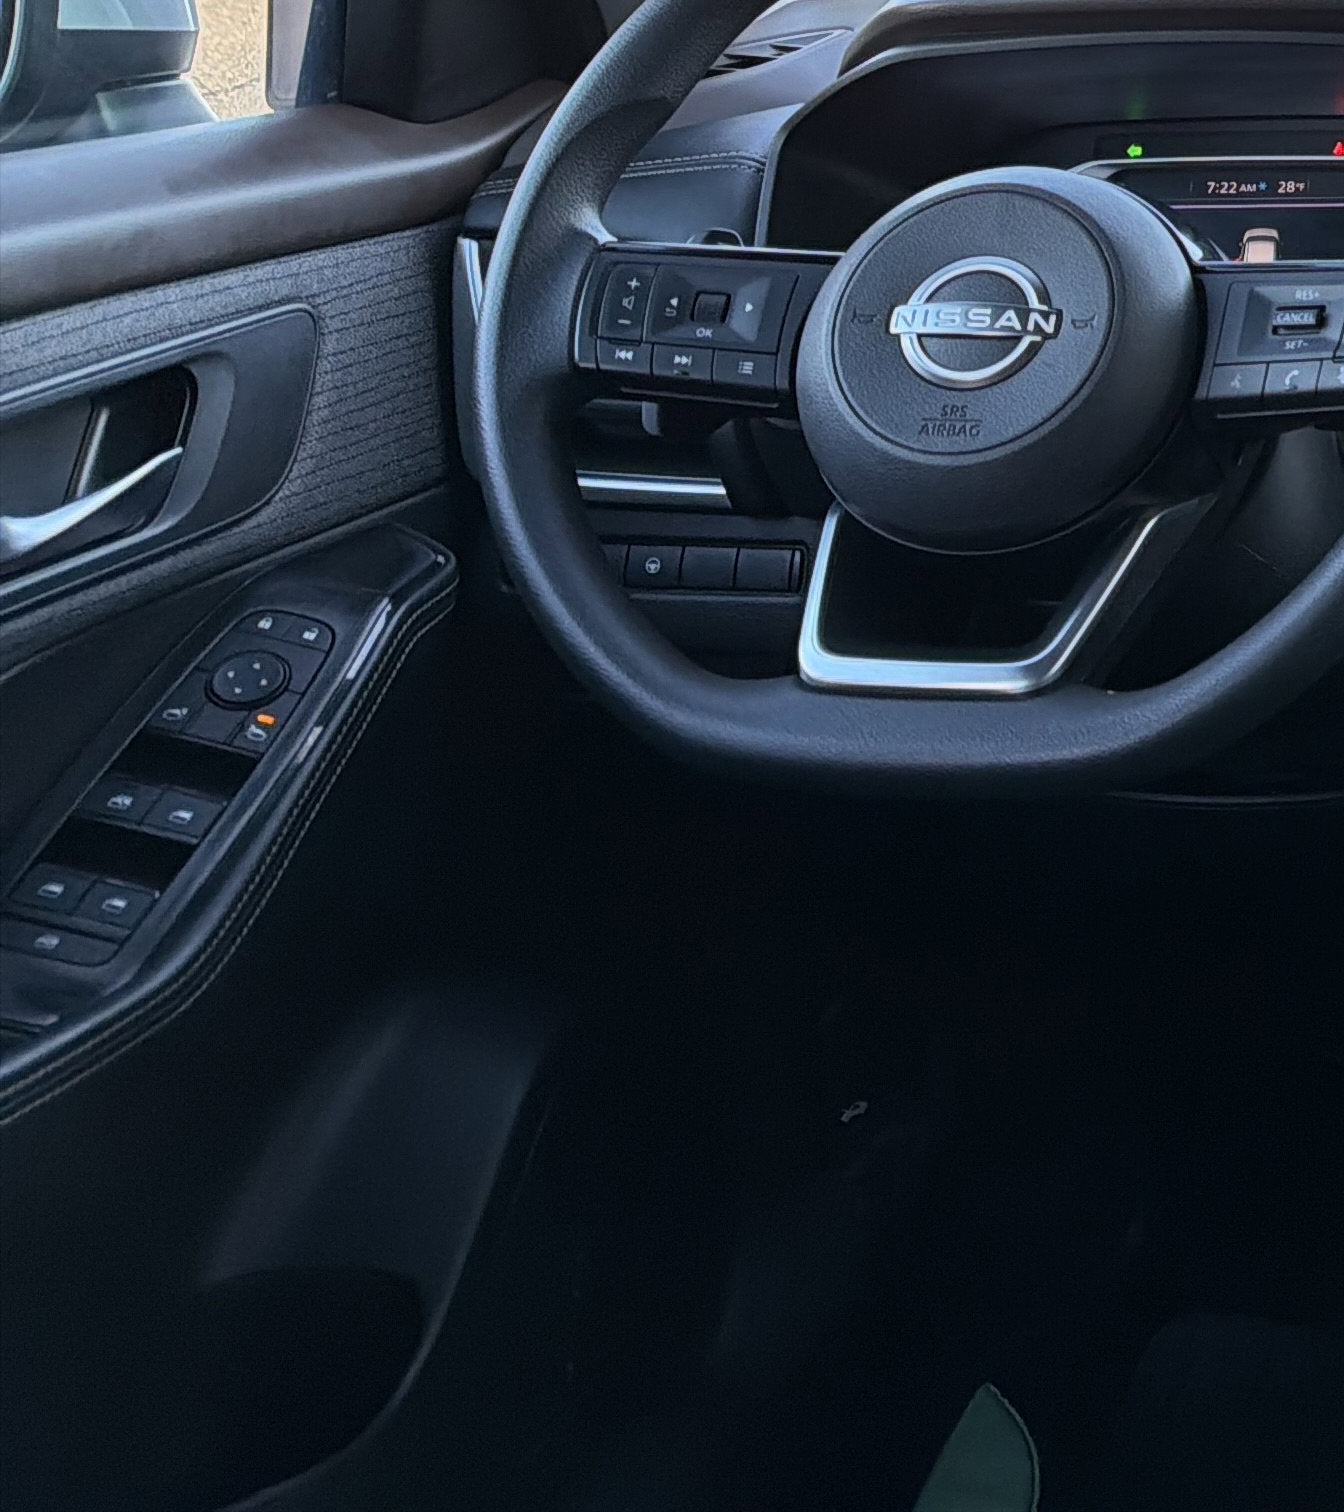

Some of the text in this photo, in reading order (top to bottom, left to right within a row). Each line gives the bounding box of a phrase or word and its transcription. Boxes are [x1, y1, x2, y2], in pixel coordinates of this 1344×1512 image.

[1207, 181, 1256, 194] 7:22 AM
[895, 308, 1057, 334] NISSAN
[1275, 312, 1315, 323] CANCEL
[696, 327, 713, 338] OK
[940, 404, 969, 417] SRS
[918, 423, 981, 437] AIRBAG
